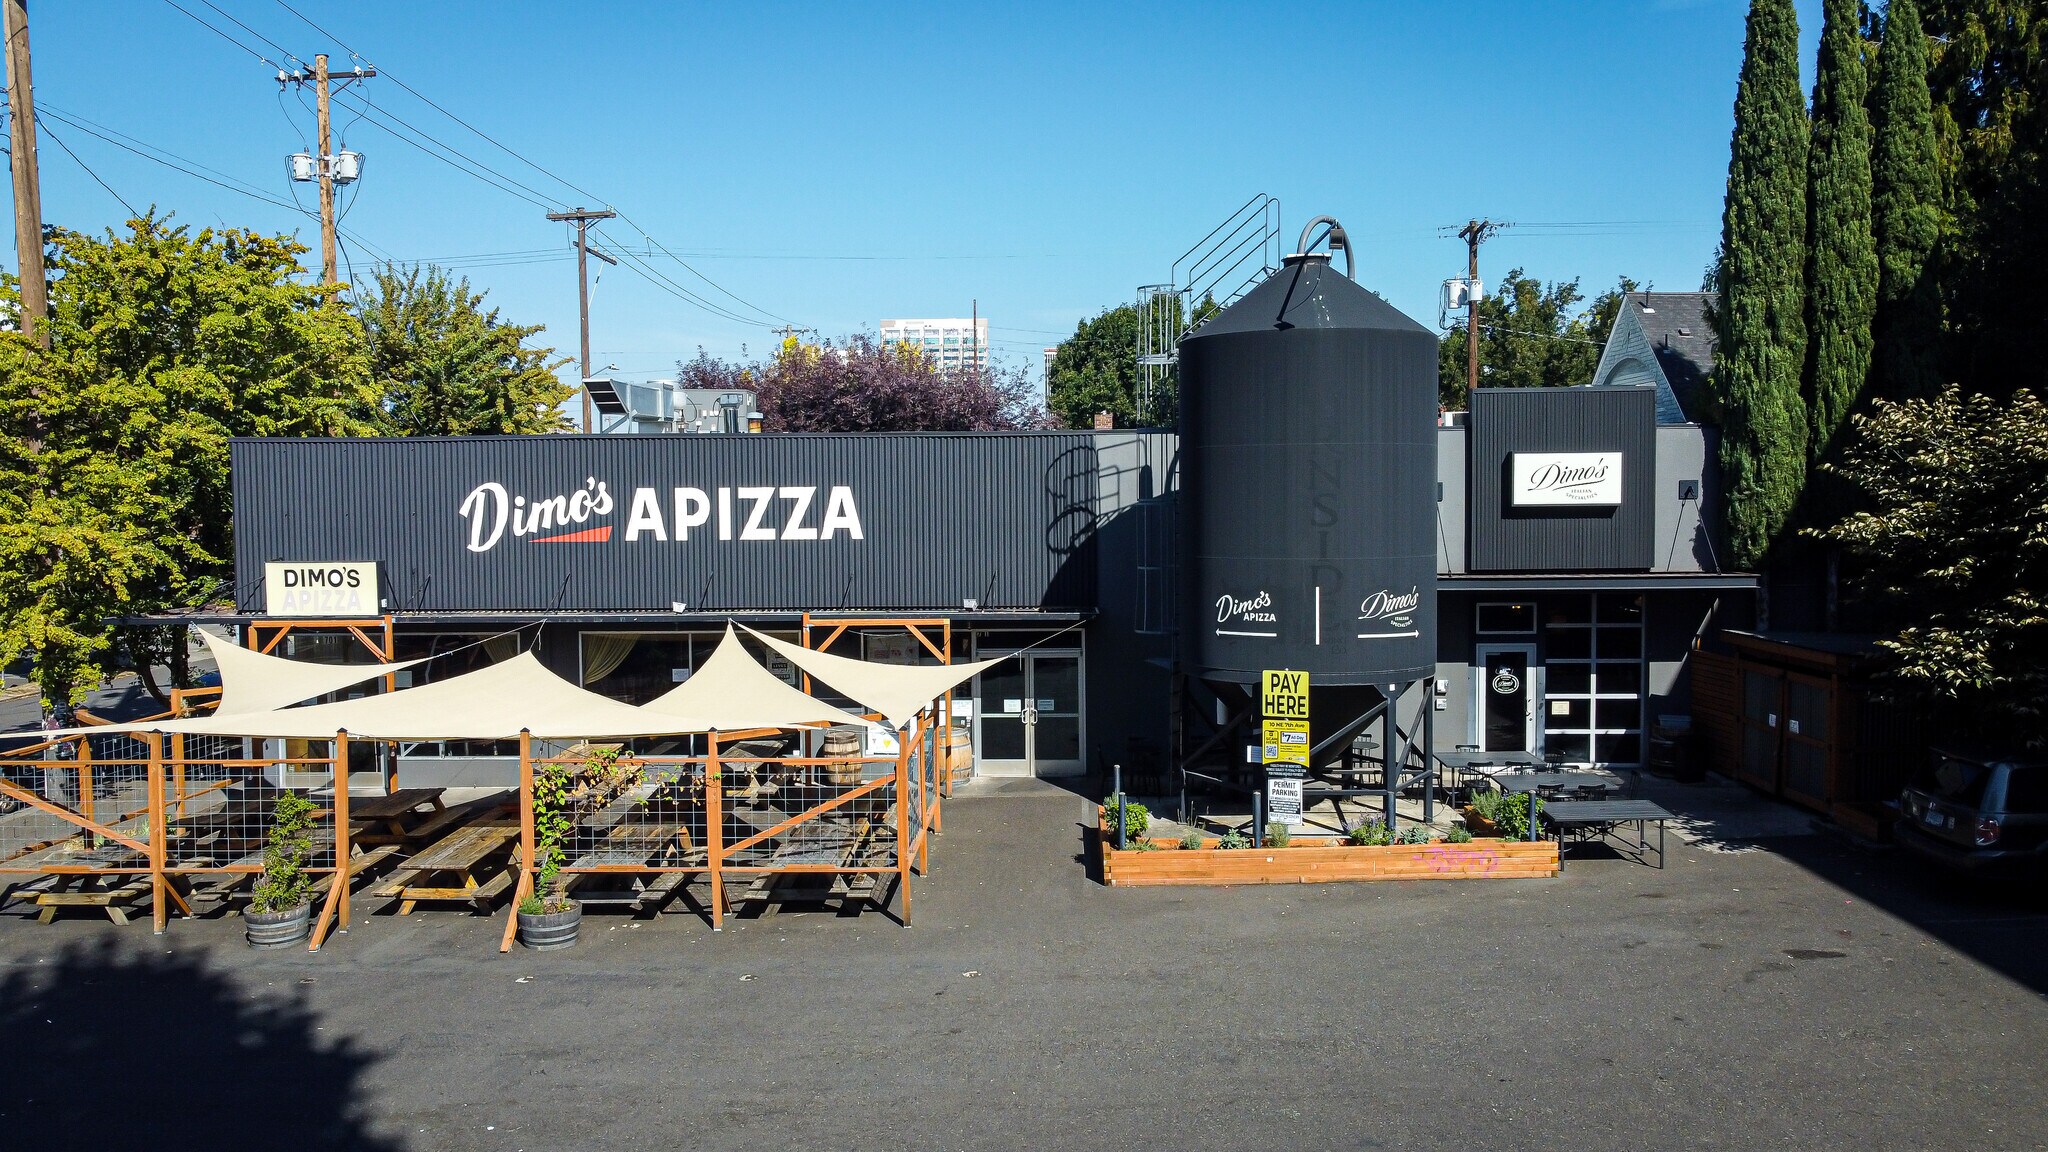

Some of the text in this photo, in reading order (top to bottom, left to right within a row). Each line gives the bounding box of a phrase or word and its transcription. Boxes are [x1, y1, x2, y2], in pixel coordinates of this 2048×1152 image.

[1527, 457, 1609, 491] Dimo's
[458, 476, 865, 553] Dimo's APIZZA
[284, 566, 361, 588] DIMO'S
[282, 590, 361, 612] APIZZA
[1215, 590, 1271, 623] Dimo's
[1358, 585, 1419, 620] Dimo's
[1243, 612, 1277, 622] APIZZA
[1270, 673, 1301, 694] PAY
[1265, 694, 1306, 715] HERE
[1271, 788, 1298, 797] PARKING
[1273, 780, 1296, 789] PERMIT
